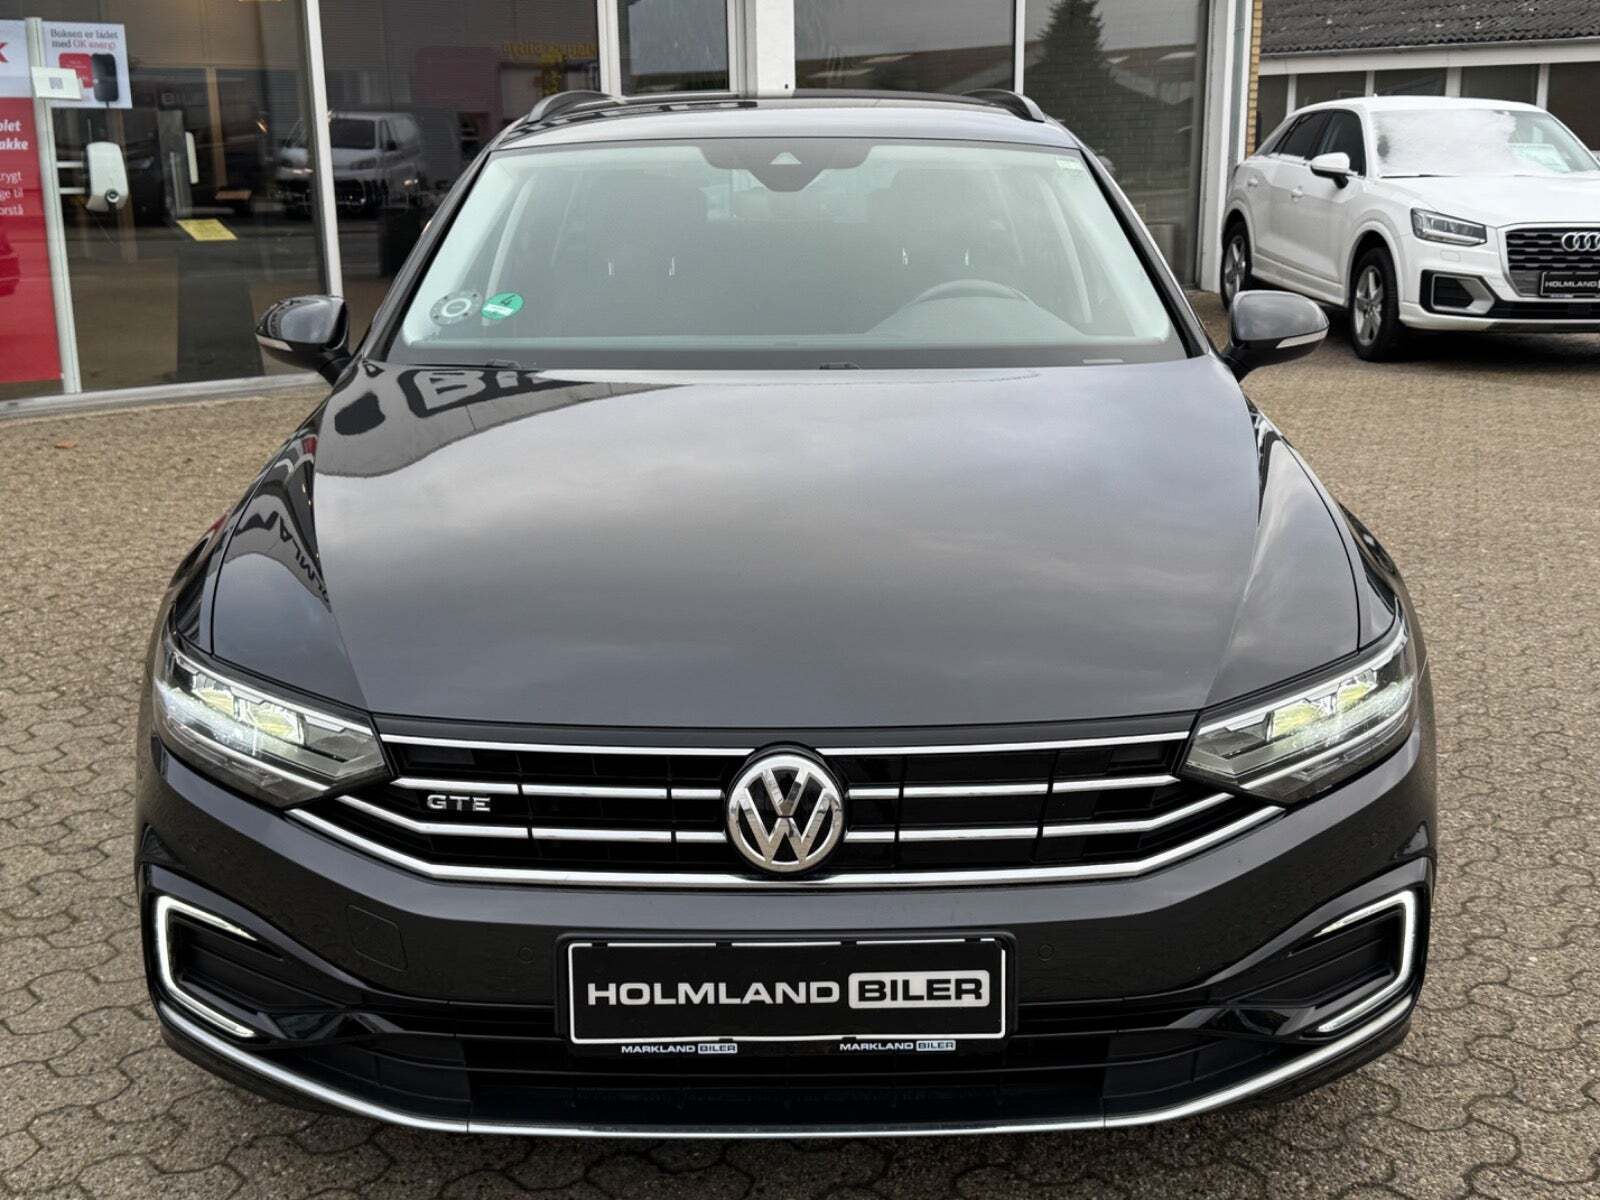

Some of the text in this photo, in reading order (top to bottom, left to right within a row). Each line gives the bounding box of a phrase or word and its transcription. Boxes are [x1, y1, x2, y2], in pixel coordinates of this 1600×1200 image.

[52, 40, 72, 48] med
[73, 40, 87, 48] OK
[427, 794, 491, 812] GTE
[587, 978, 983, 1005] HOLMLAND BILER
[621, 1044, 737, 1053] MARKLAND BILER
[839, 1041, 955, 1051] MARKLAND BILER
